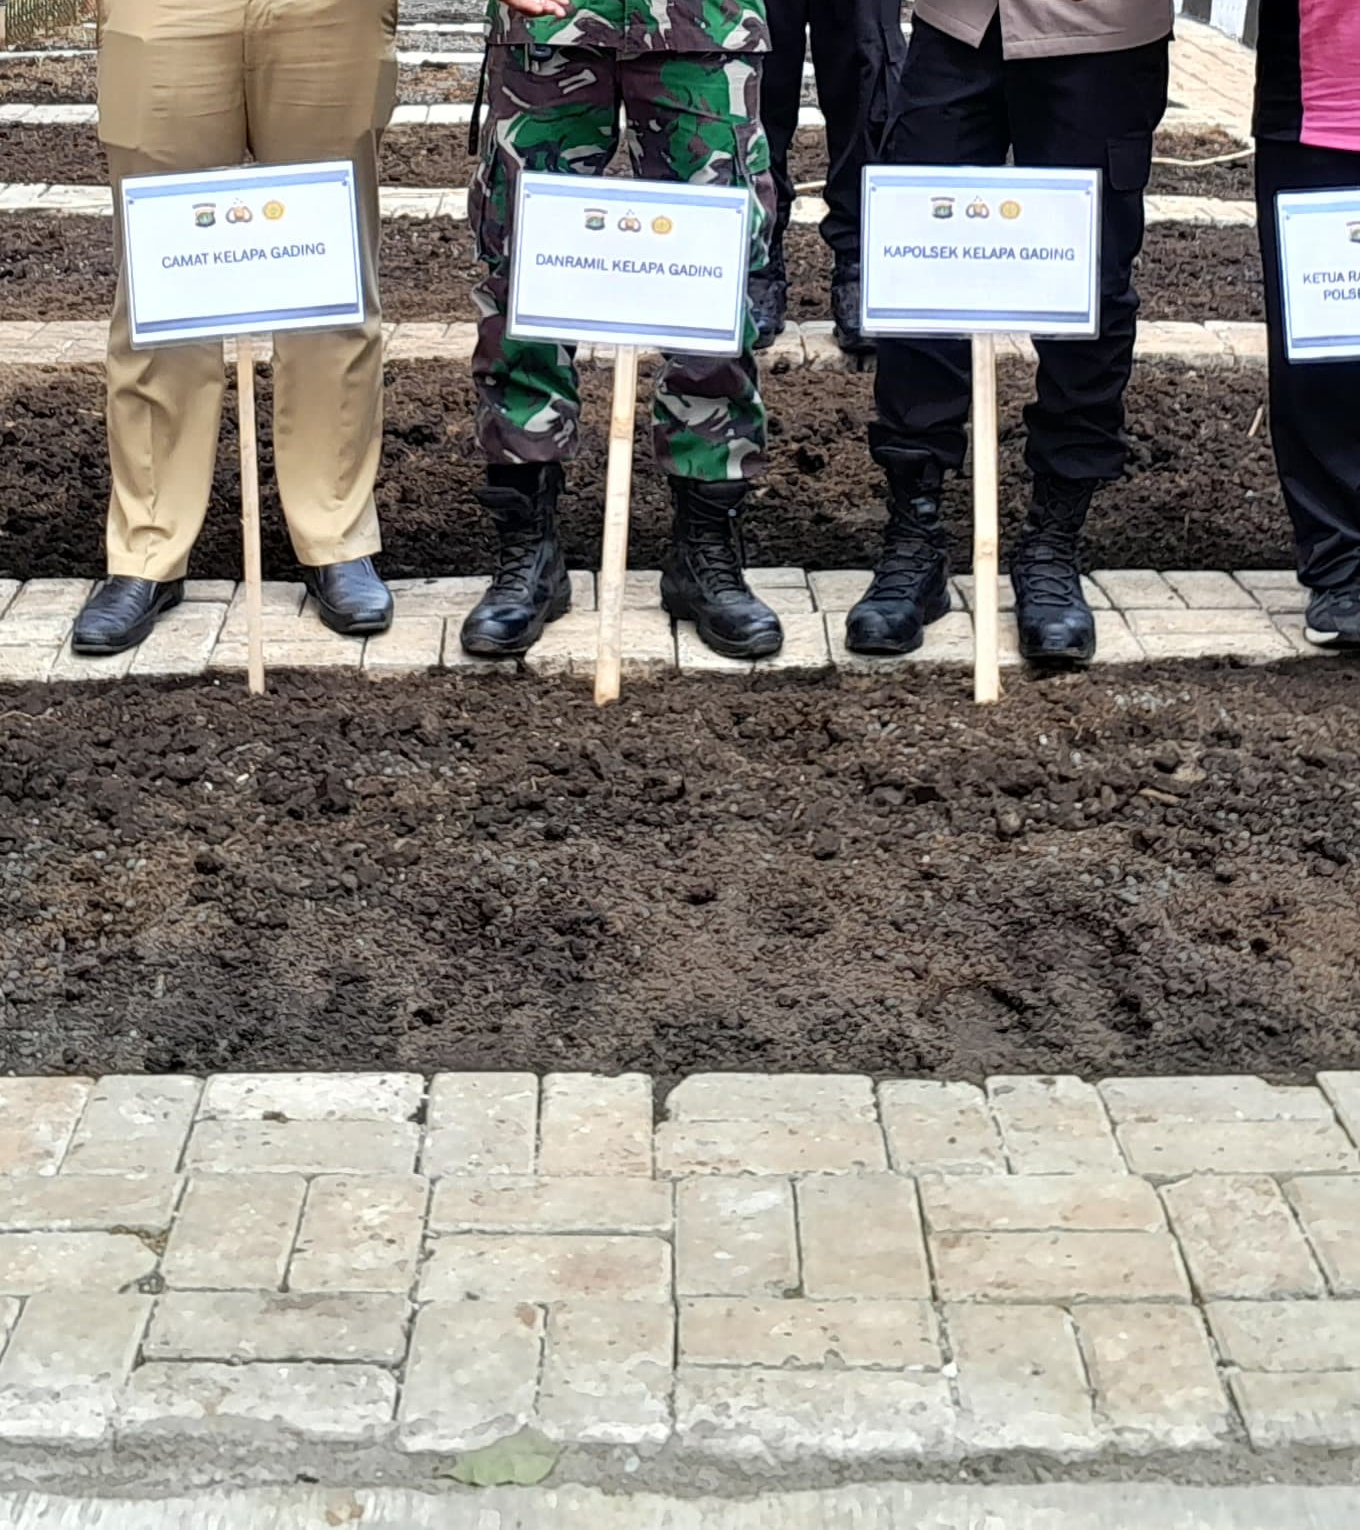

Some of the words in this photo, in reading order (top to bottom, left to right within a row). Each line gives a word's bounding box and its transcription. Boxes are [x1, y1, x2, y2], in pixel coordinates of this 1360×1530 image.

[162, 252, 209, 269] CAMAT
[213, 248, 267, 264] KELAPA
[270, 242, 326, 259] GADING
[883, 245, 958, 259] KAPOLSEK
[962, 246, 1016, 260] KELAPA
[1019, 247, 1075, 261] GADING
[536, 253, 608, 271] DANRAMIL
[612, 260, 665, 275] KELAPA
[668, 263, 723, 278] GADING
[1303, 271, 1345, 285] KETUA
